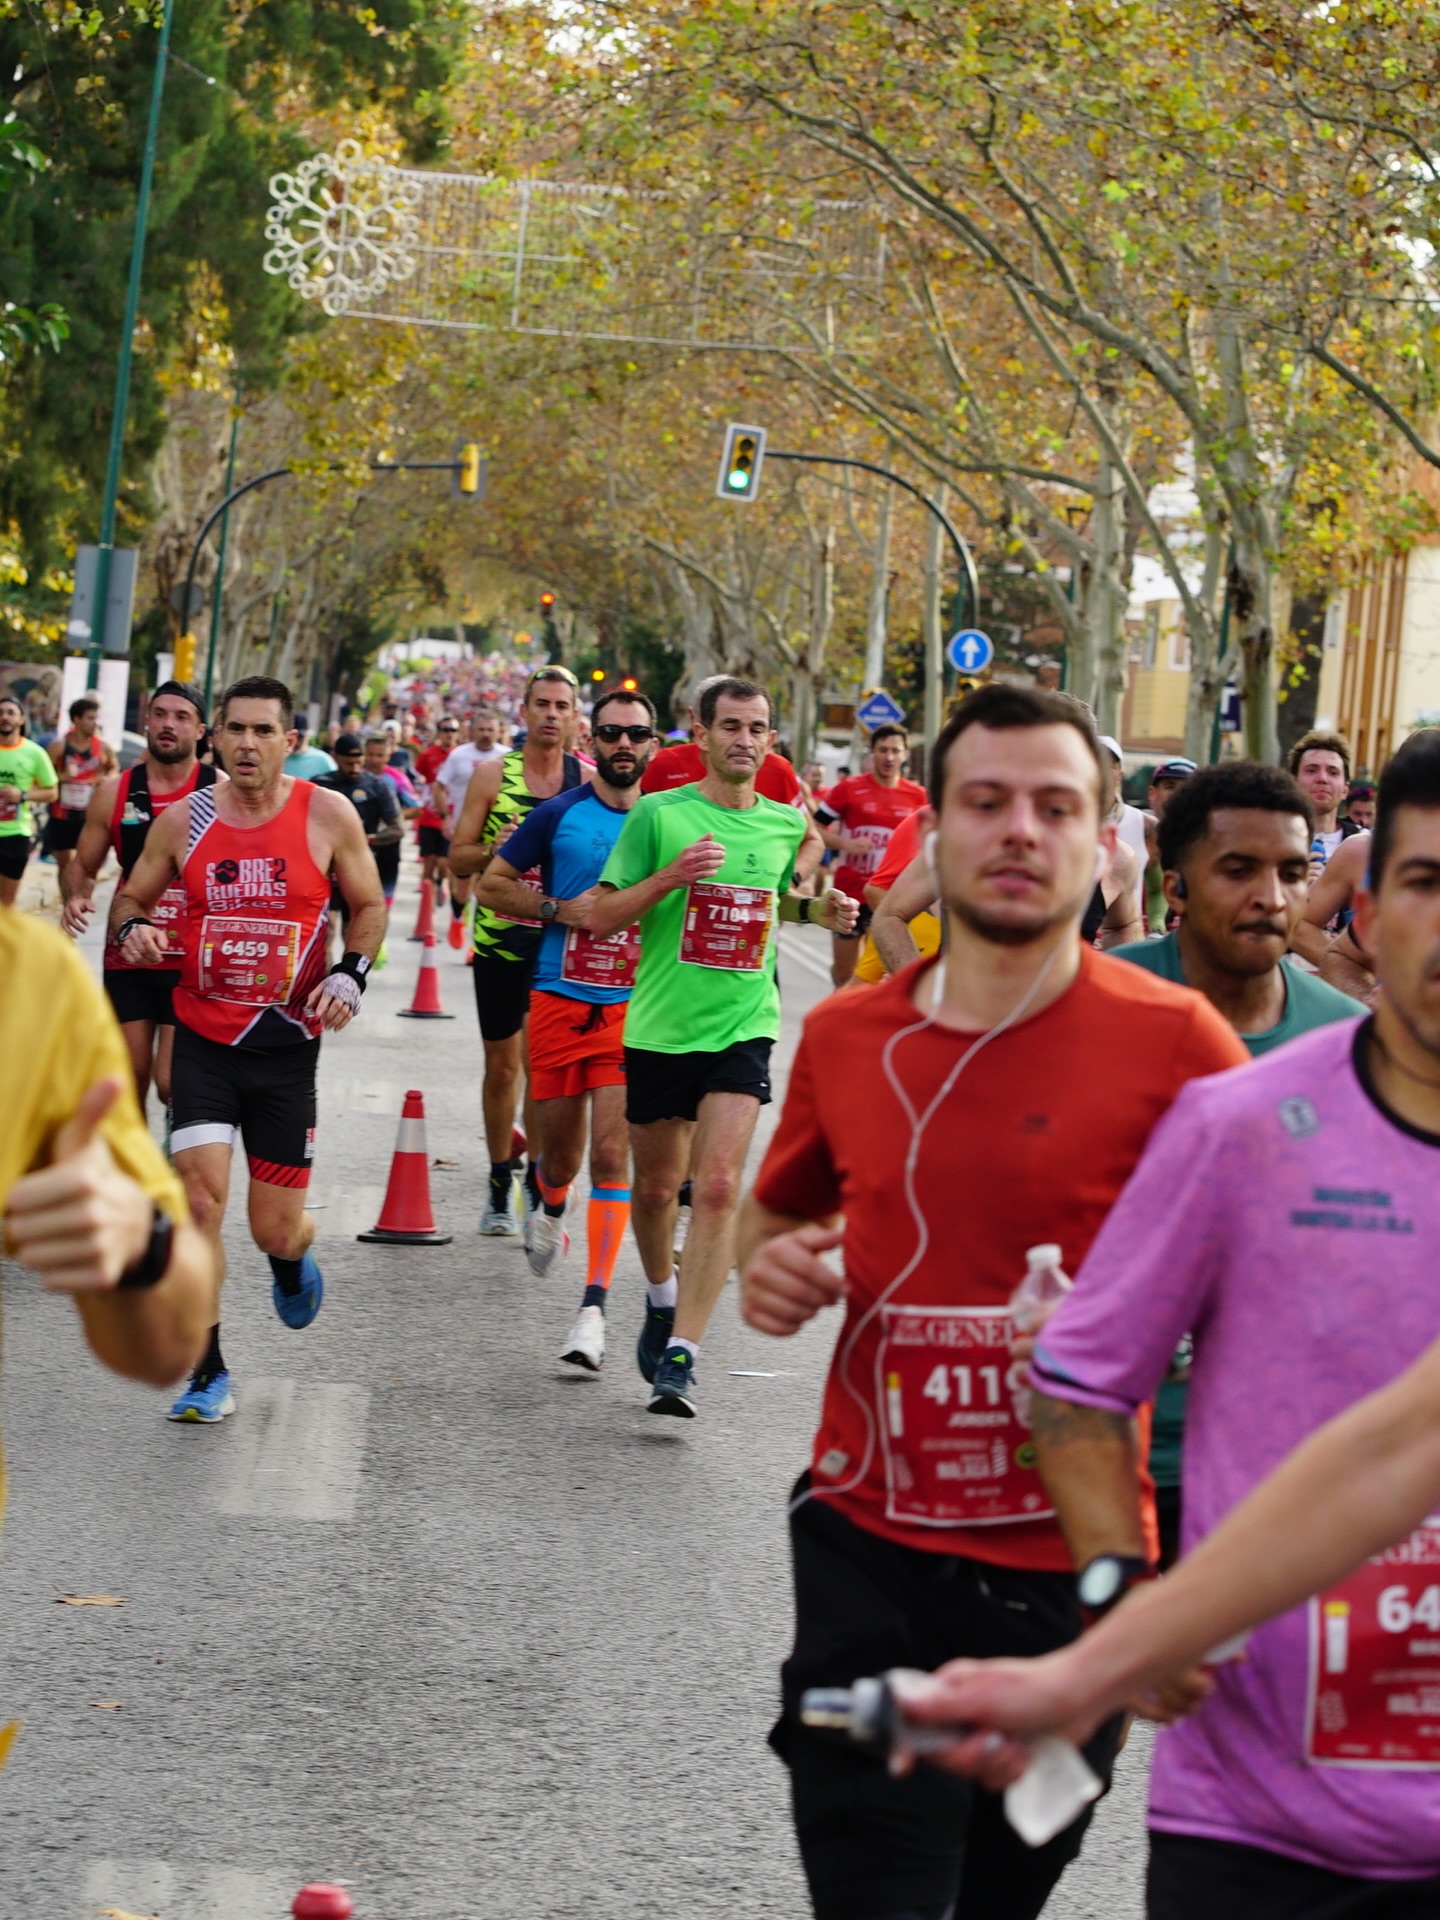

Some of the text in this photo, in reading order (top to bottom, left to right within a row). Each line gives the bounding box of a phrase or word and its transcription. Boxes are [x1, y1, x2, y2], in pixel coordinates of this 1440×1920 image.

[206, 882, 287, 901] RUEDAS
[707, 904, 751, 924] 7104
[221, 939, 270, 958] 6459
